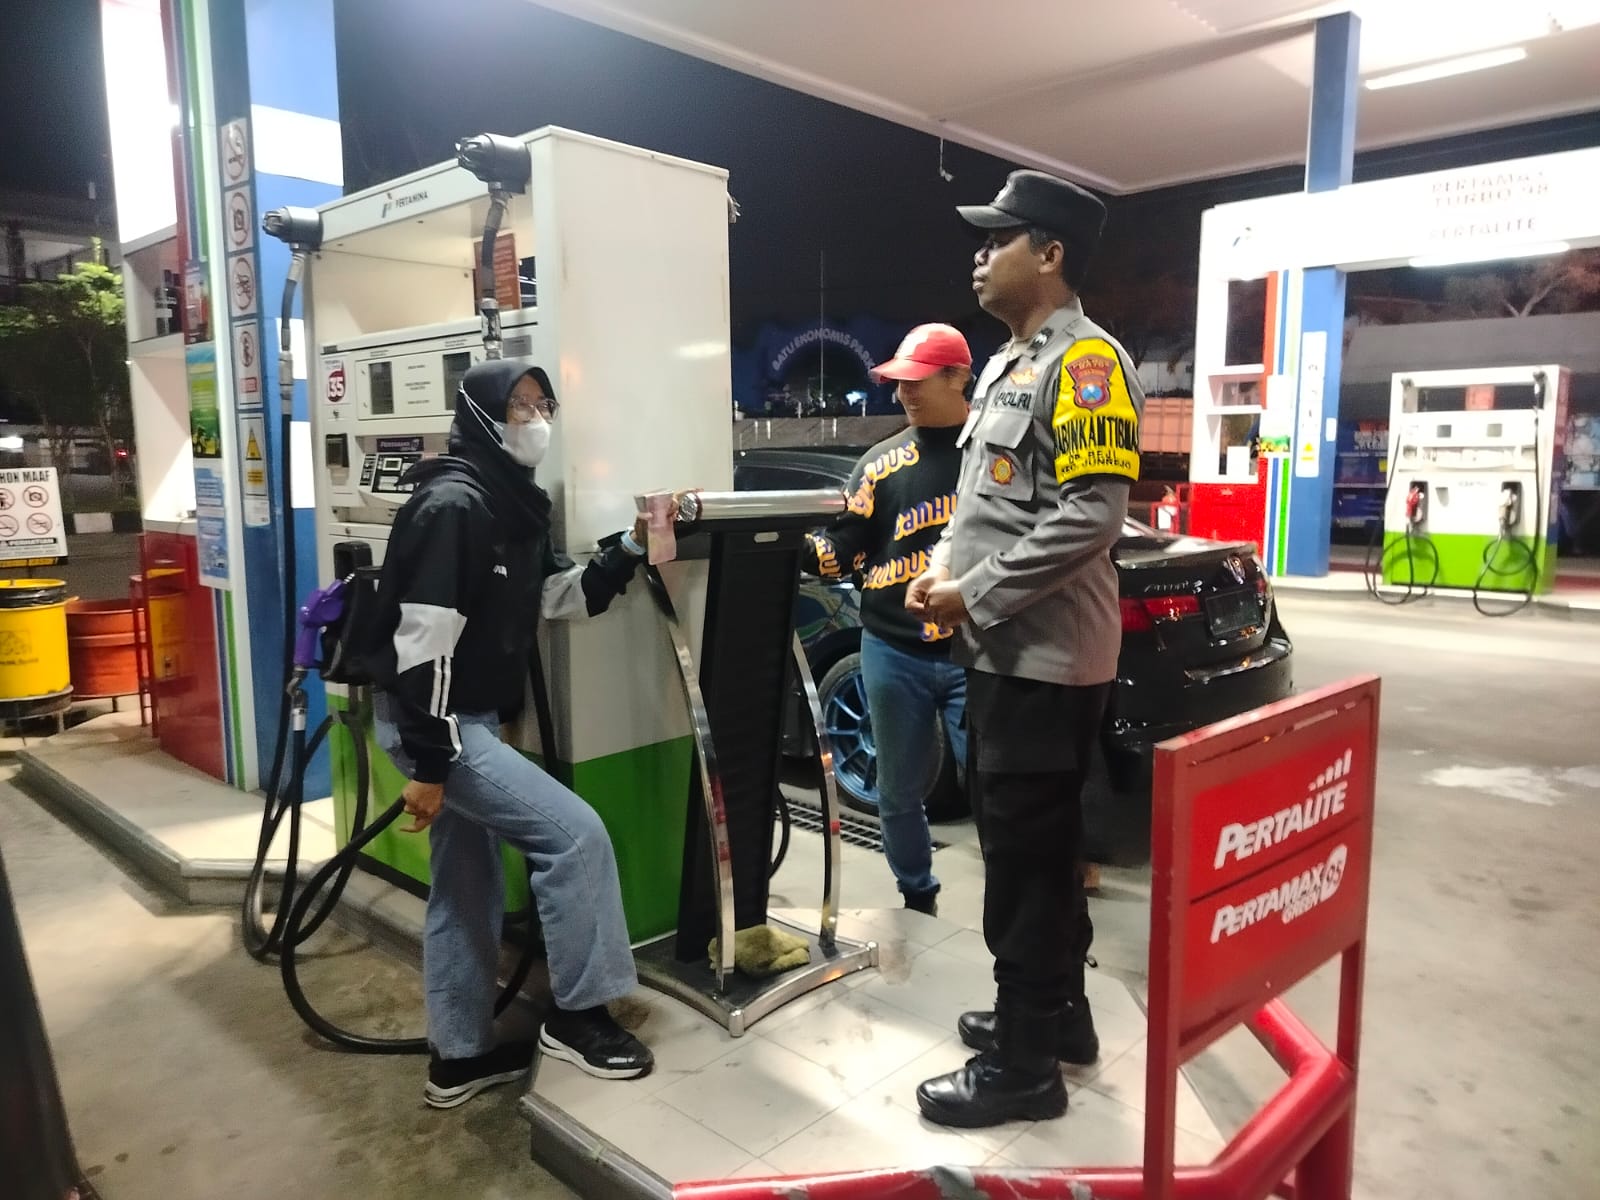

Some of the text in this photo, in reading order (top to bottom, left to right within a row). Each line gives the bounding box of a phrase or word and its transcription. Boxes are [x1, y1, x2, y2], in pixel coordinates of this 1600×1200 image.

[772, 342, 795, 371] BATU
[795, 328, 851, 348] EKONOMIS
[994, 391, 1032, 411] POLRI
[23, 470, 50, 483] MAAF
[1214, 780, 1348, 870] PERTALITE
[1210, 862, 1325, 944] PERTAMAX
